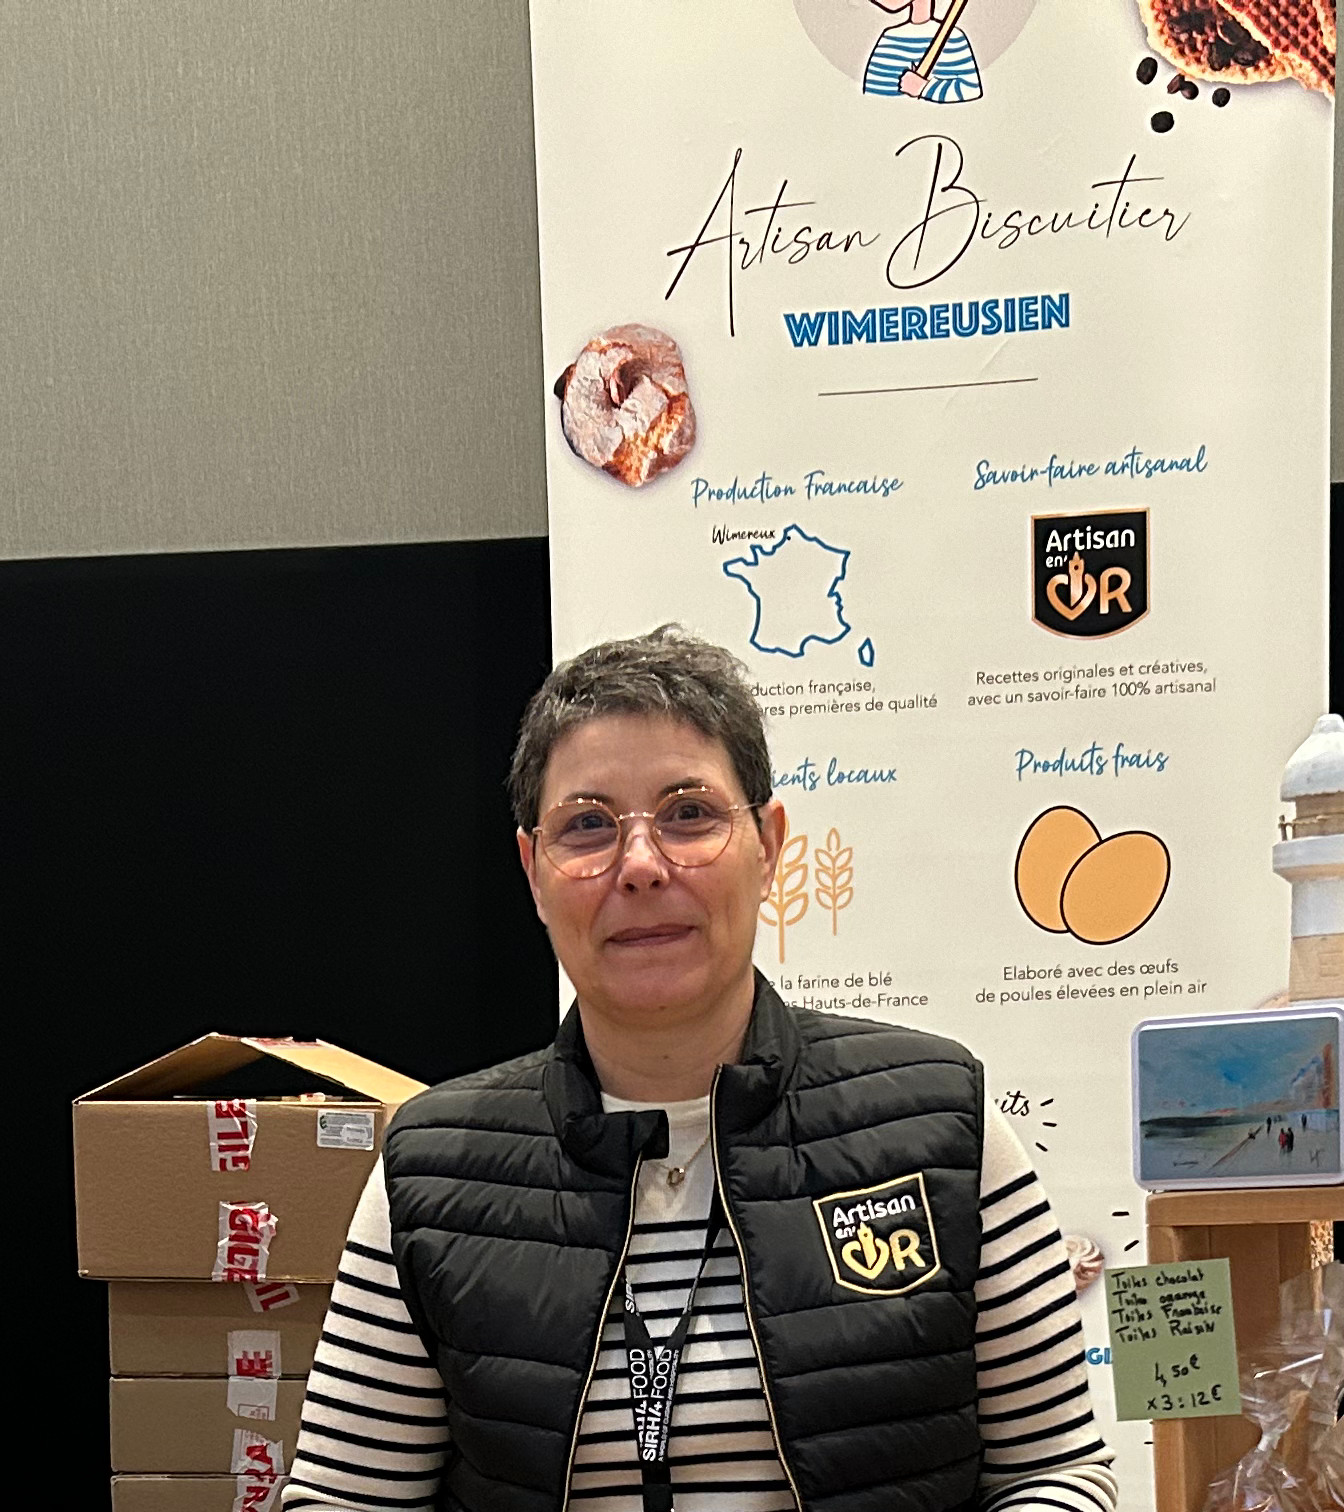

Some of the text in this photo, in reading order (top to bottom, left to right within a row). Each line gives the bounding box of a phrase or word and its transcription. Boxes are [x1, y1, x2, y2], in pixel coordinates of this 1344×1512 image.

[665, 134, 1194, 337] Artisan Biscuitier
[783, 292, 1072, 349] WIMEREUSIEN
[1103, 444, 1210, 478] artisanal
[690, 472, 798, 508] Production
[711, 524, 777, 546] Wimereux
[1044, 527, 1137, 555] Artisan
[976, 657, 1209, 687] Recettes originales et créatives,
[807, 678, 877, 697] française,
[967, 676, 1218, 706] avec un savoir-faire 100% artisanal
[788, 696, 860, 718] premières
[863, 699, 883, 713] de
[886, 694, 939, 717] qualité
[825, 757, 899, 789] locaux
[1014, 741, 1170, 783] Produits frais
[779, 974, 795, 992] la
[797, 972, 841, 992] farine
[843, 971, 865, 989] de
[866, 968, 894, 988] blé
[1002, 962, 1063, 983] Elaboré
[1066, 964, 1105, 981] avec
[1106, 961, 1137, 978] des
[975, 978, 1209, 1007] de poules élevées en plein air
[832, 1194, 917, 1228] Artisan
